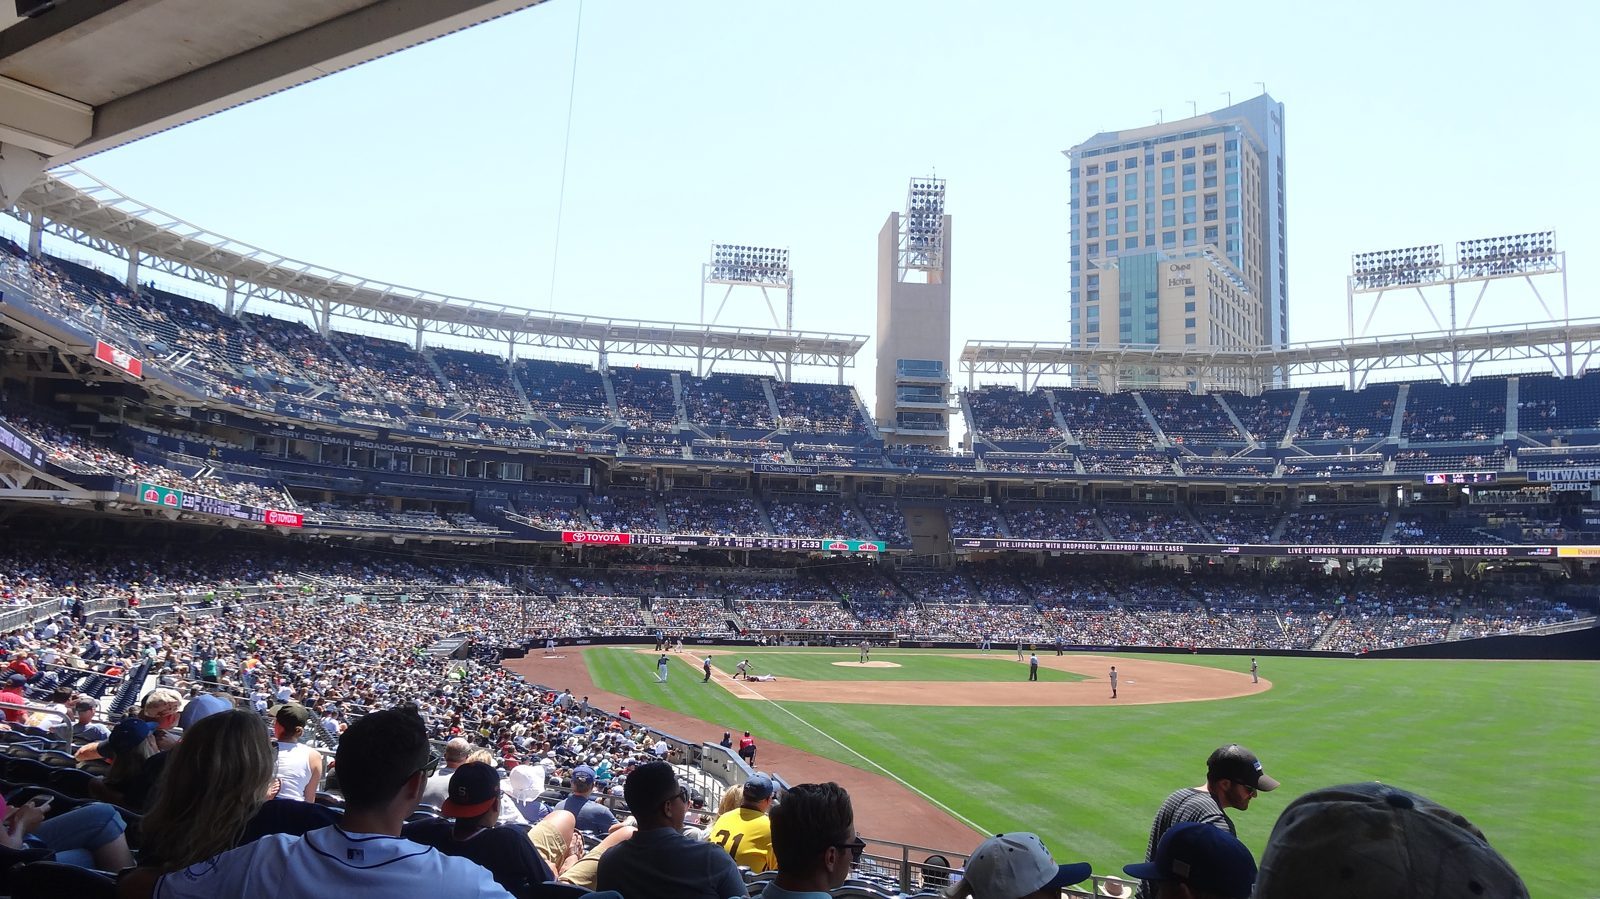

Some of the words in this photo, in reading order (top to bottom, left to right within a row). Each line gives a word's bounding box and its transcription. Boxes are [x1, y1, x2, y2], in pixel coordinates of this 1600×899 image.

[270, 429, 300, 439] JERRY
[304, 433, 350, 446] COLEMAN
[354, 441, 413, 453] BROADCAST
[417, 448, 457, 457] CENTER
[780, 465, 795, 473] Diego
[1537, 470, 1600, 481] CUTWATER
[1551, 482, 1591, 491] SPIRITS
[277, 513, 298, 524] TOYOTA
[586, 533, 621, 542] TOYOTA
[651, 536, 661, 544] 15
[1011, 541, 1044, 549] LIFEPROOF
